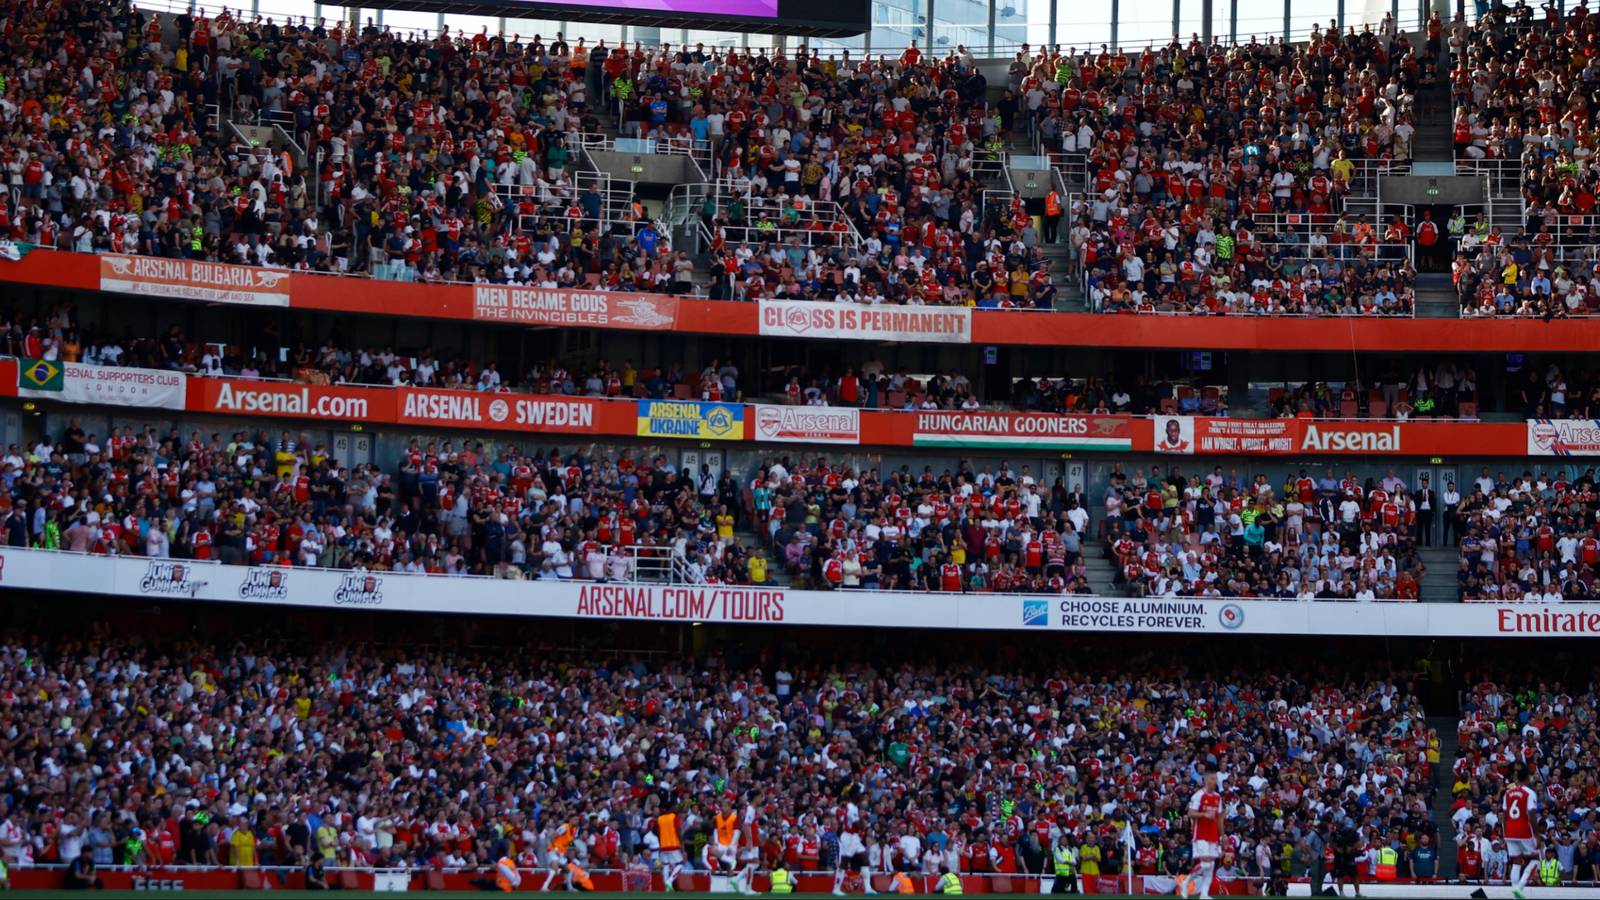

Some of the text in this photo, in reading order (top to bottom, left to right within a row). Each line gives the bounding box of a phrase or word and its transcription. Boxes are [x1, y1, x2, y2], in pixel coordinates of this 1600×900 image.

[133, 258, 254, 287] ARSENAL BULGARIA
[476, 287, 608, 313] MEN BECAME GODS
[476, 306, 609, 324] THE INVINCIBLES
[839, 310, 857, 330] IS
[860, 311, 966, 334] PERMANENT
[97, 370, 155, 385] SUPPORTERS
[156, 375, 180, 386] CLUB
[215, 382, 368, 418] Arsenal.com
[404, 393, 593, 427] ARSENAL SWEDEN
[648, 401, 703, 419] ARSENAL
[650, 418, 701, 436] UKRAINE
[781, 407, 858, 432] Arsenal
[918, 414, 1088, 434] HUNGARIAN GOONERS
[1201, 436, 1213, 450] IAN
[1268, 438, 1293, 451] WRIGHT
[1302, 424, 1401, 450] Arsenal
[1071, 466, 1082, 477] 47
[1443, 471, 1454, 481] 48
[577, 585, 785, 621] ARSENAL.COM/TOURS
[1060, 601, 1208, 615] CHOOSE ALUMINIUM.
[1061, 614, 1205, 628] RECYCLES FOREVER.
[1497, 608, 1600, 633] Emirate
[1509, 799, 1521, 820] 6
